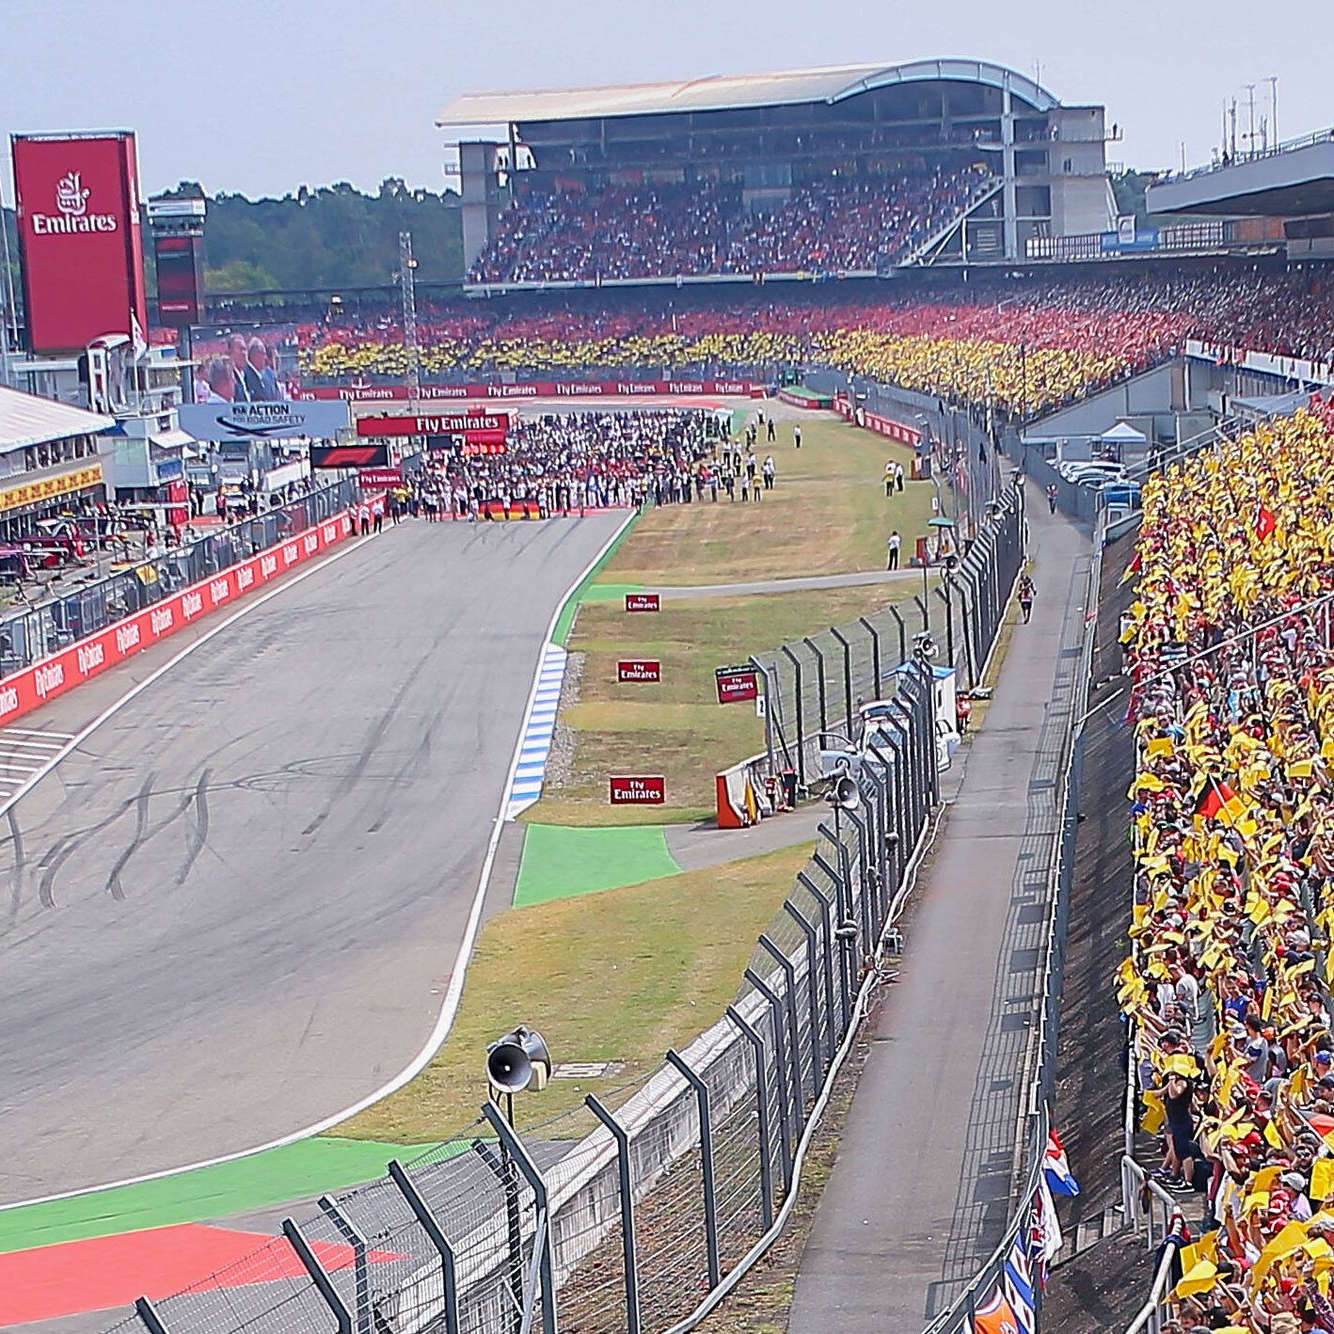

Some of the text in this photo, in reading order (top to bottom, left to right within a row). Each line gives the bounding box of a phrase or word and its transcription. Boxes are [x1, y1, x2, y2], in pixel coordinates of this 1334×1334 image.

[32, 213, 117, 235] Emirates
[339, 388, 394, 400] Fly Emirates
[417, 387, 467, 399] Fly Emirates
[487, 385, 537, 397] Fly Emirates
[557, 384, 602, 395] Fly Emirates
[249, 404, 289, 415] ACTION
[271, 414, 306, 423] SAFETY
[417, 415, 499, 432] Fly Emirates
[361, 474, 400, 483] Fly Emirates
[628, 601, 658, 609] Emirates
[621, 664, 658, 679] Fly Emirates
[721, 682, 754, 692] Emirates
[614, 781, 661, 800] Fly Emirates
